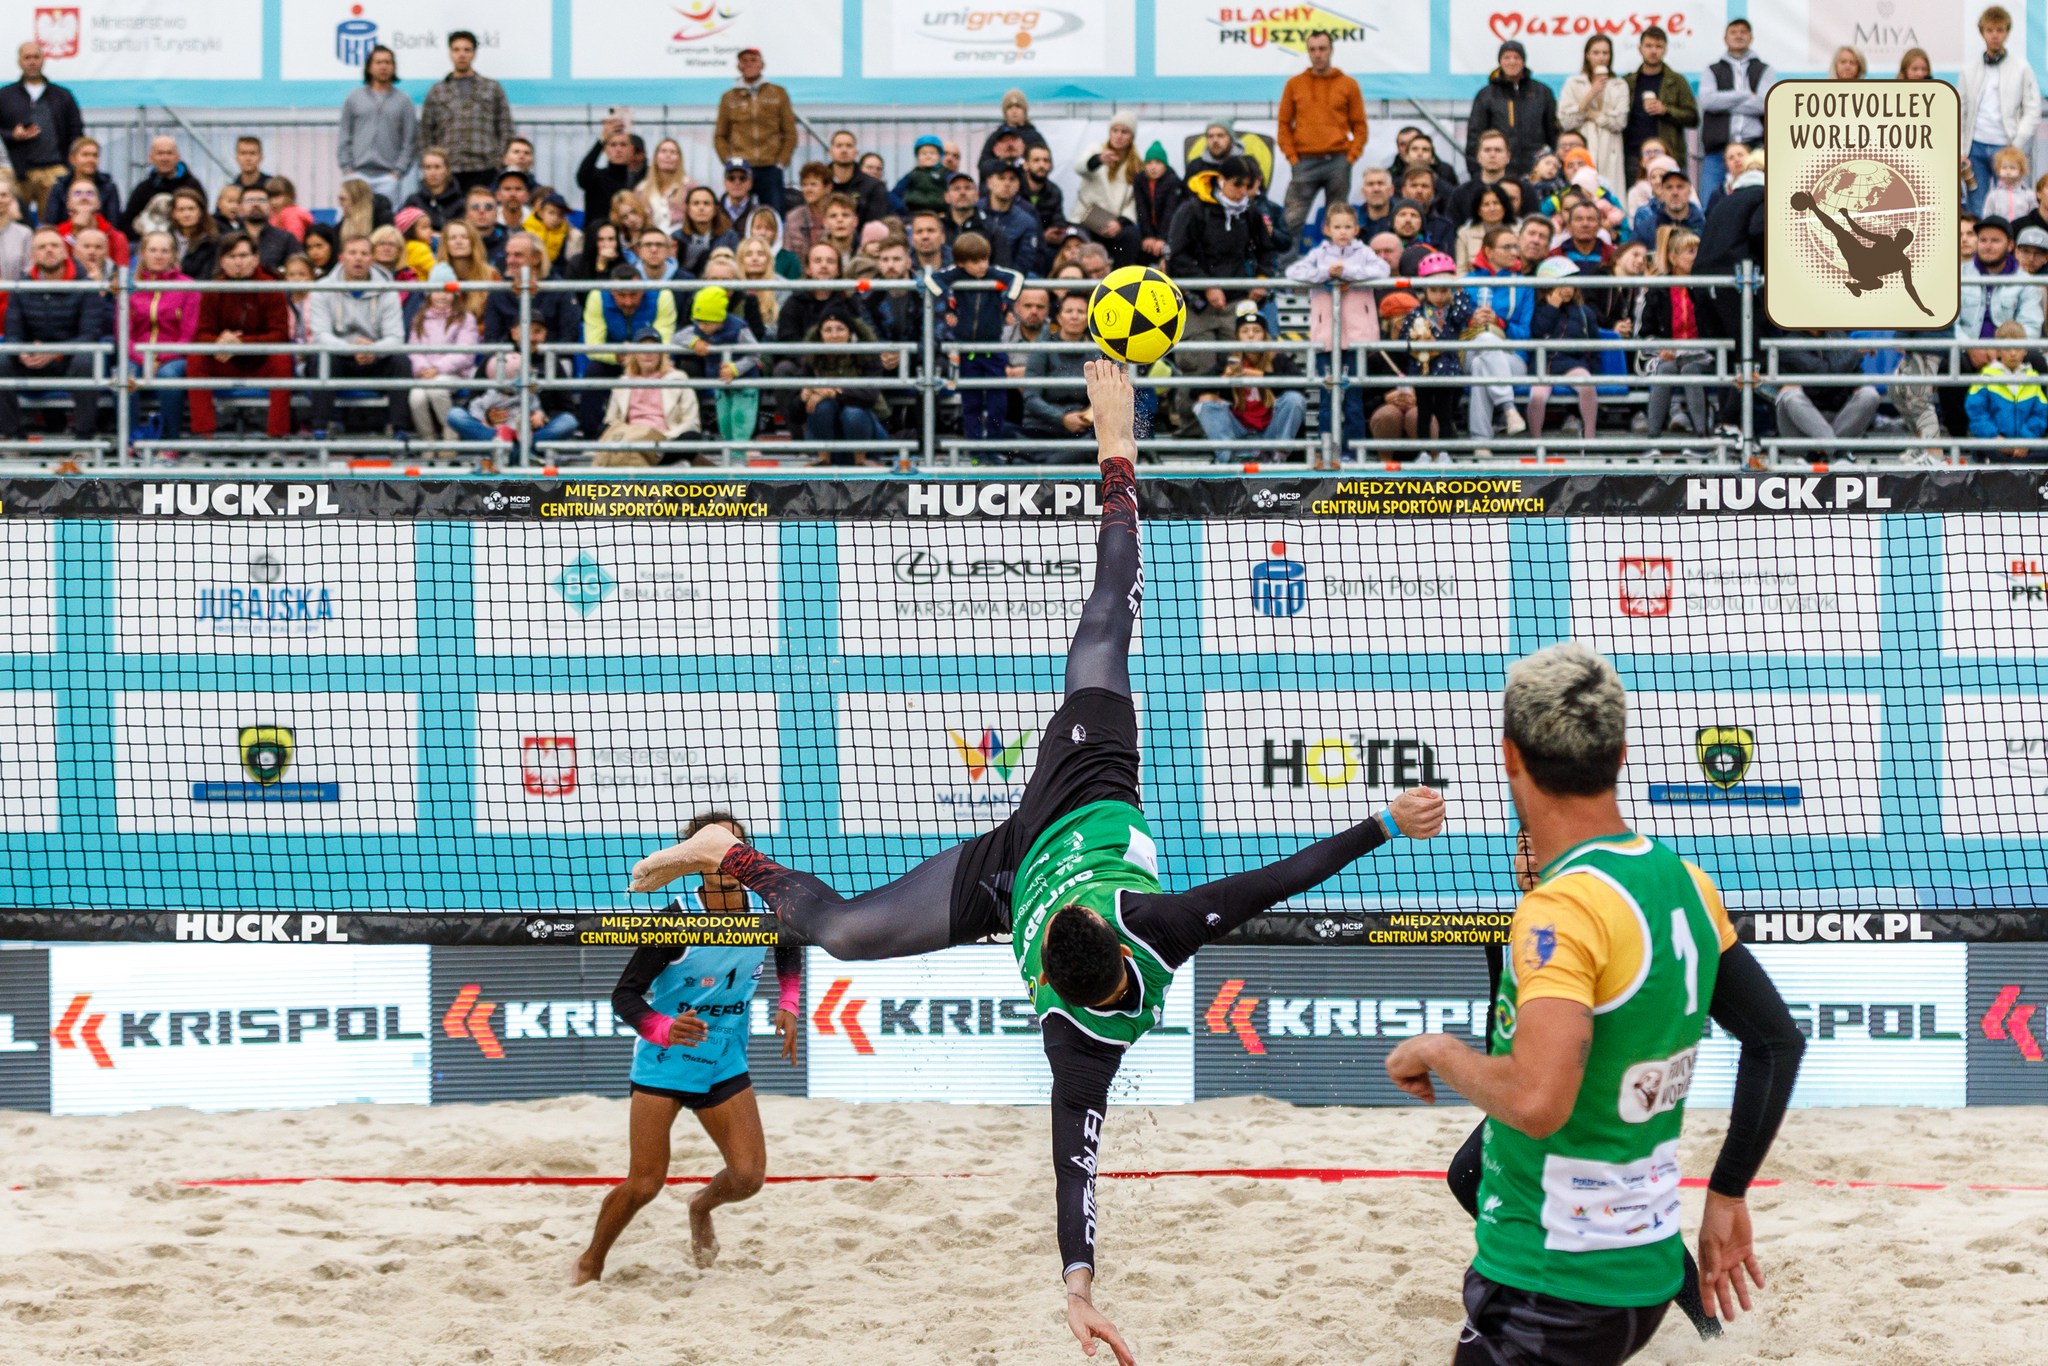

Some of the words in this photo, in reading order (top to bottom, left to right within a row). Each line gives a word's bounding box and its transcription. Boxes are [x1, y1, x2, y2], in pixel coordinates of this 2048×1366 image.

[923, 7, 1040, 31] unigreg
[1220, 7, 1313, 22] BLACHY
[1220, 27, 1365, 48] PRUSZYSKI
[565, 484, 747, 500] MIĘDZYNARODOWE
[1336, 480, 1522, 498] MIĘDZYNARODOWE
[1686, 476, 1892, 511] HUCK.PL
[141, 484, 340, 516] HUCK.PL
[540, 502, 607, 517] CENTRUM
[609, 500, 678, 517] SPORTÓW
[681, 499, 768, 517] PLAŻOWYCH
[907, 484, 1103, 516] HUCK.PL
[1311, 500, 1380, 515] CENTRUM
[1382, 497, 1453, 514] SPORTÓW
[1456, 495, 1544, 513] PLAŻOWYCH
[947, 559, 1081, 577] LEXUS
[1323, 574, 1380, 597] Bank
[1390, 574, 1455, 597] Polski
[198, 587, 333, 622] JURAJSKA
[898, 602, 1001, 617] WARSZAWA
[936, 787, 1022, 808] WILANÓ
[175, 913, 348, 942] HUCK.PL
[601, 916, 760, 930] MIĘDZYNARODOWE
[1390, 915, 1515, 929] MIĘDZYNAROD
[1754, 913, 1933, 941] HUCK.PL
[580, 931, 638, 944] CENTRUM
[641, 930, 700, 944] SPORTÓW
[703, 929, 779, 945] PLAŻOWYCH
[1368, 930, 1427, 944] CENTRUM
[1431, 928, 1491, 943] SPORTÓW
[1494, 929, 1514, 943] PLA
[1670, 907, 1699, 1016] 1
[725, 967, 737, 990] 1
[120, 1006, 427, 1048] KRISPOL
